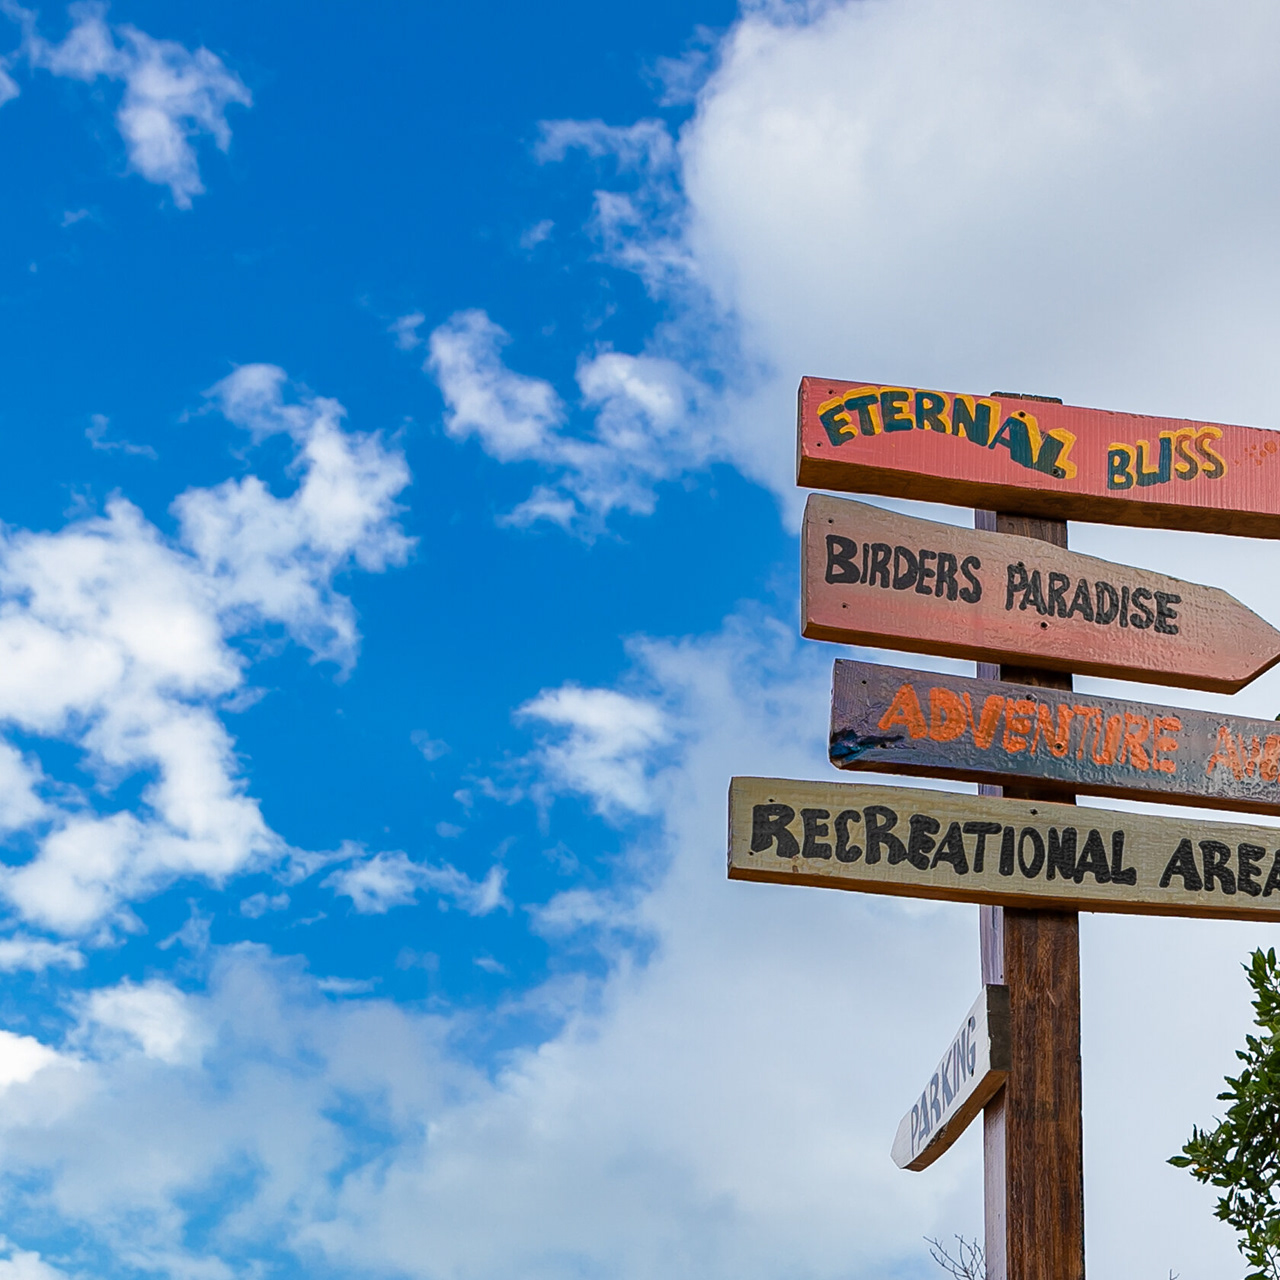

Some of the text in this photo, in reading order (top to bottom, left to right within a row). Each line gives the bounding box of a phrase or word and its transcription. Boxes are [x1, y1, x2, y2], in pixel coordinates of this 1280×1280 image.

[816, 385, 1228, 491] ETERNAL BLISS
[824, 533, 1183, 636] BIRDERS PARADISE
[877, 682, 1181, 774] ADVENTURE
[749, 803, 1138, 886] RECREATIONAL
[910, 1015, 976, 1159] PARKING
